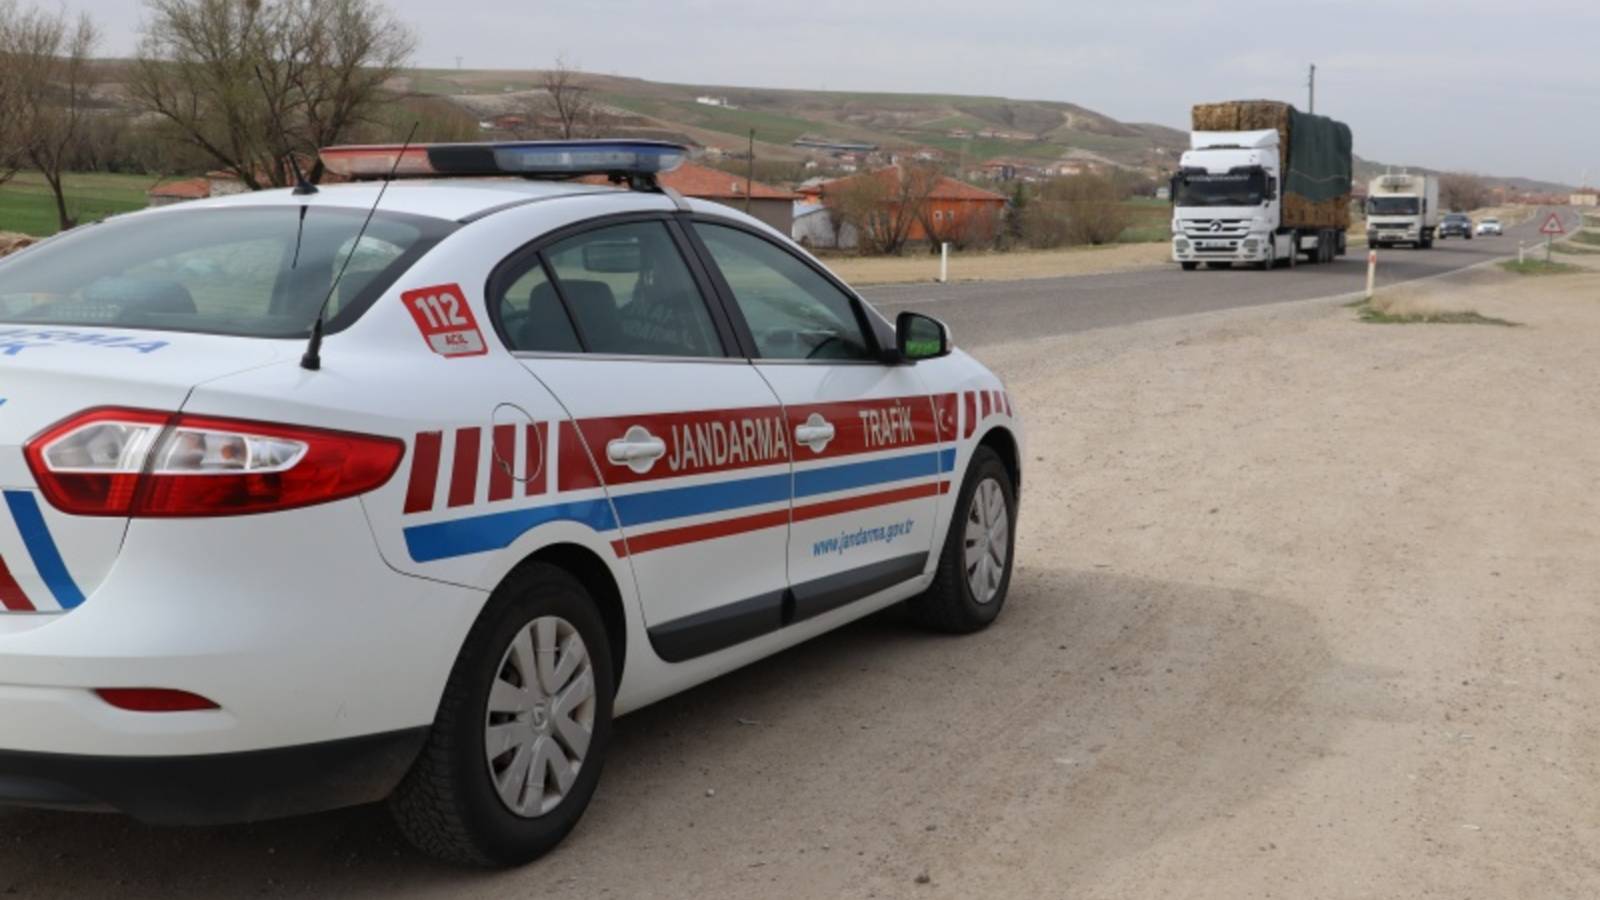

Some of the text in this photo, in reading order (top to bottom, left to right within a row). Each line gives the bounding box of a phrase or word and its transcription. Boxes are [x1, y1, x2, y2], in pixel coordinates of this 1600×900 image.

[414, 293, 467, 328] 112
[668, 399, 915, 471] JANDARMA TRAFİK
[813, 518, 914, 555] www.jandarma.gov.tr
